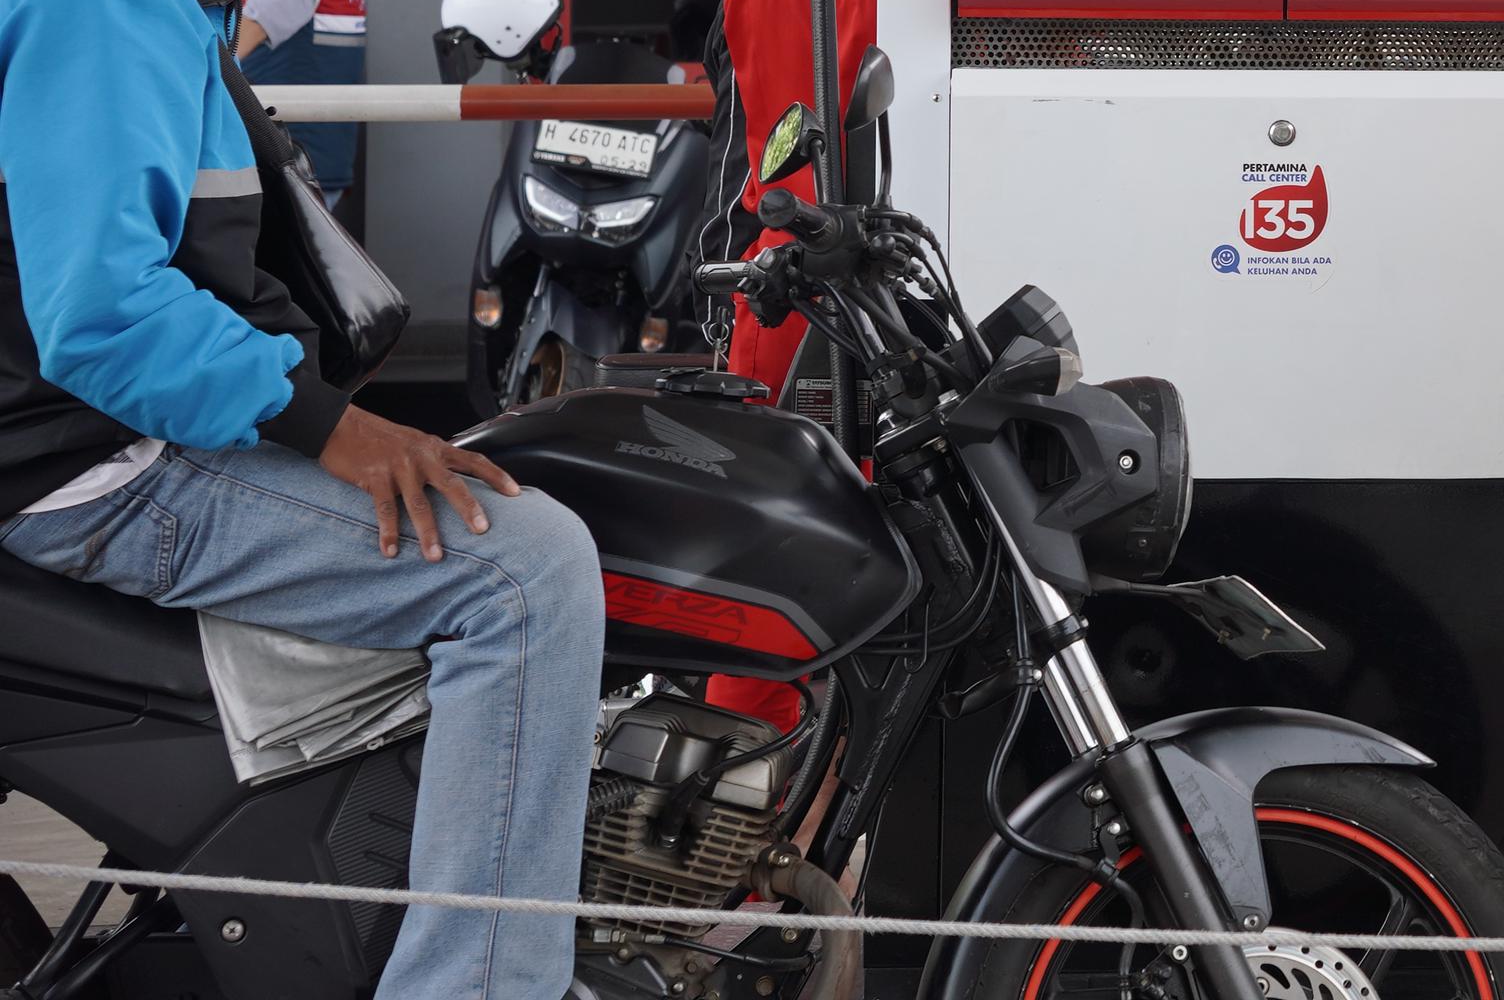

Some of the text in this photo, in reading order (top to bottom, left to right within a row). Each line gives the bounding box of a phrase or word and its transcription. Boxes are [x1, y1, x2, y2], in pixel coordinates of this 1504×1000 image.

[545, 123, 651, 154] H 4670 ATC
[1242, 163, 1308, 173] PERTAMINA
[1242, 174, 1308, 182] CALL CENTER
[1244, 199, 1315, 240] 135
[1247, 257, 1332, 265] INFOKAN BILA ADA
[614, 440, 728, 480] HONDA
[606, 580, 748, 626] VERZA
